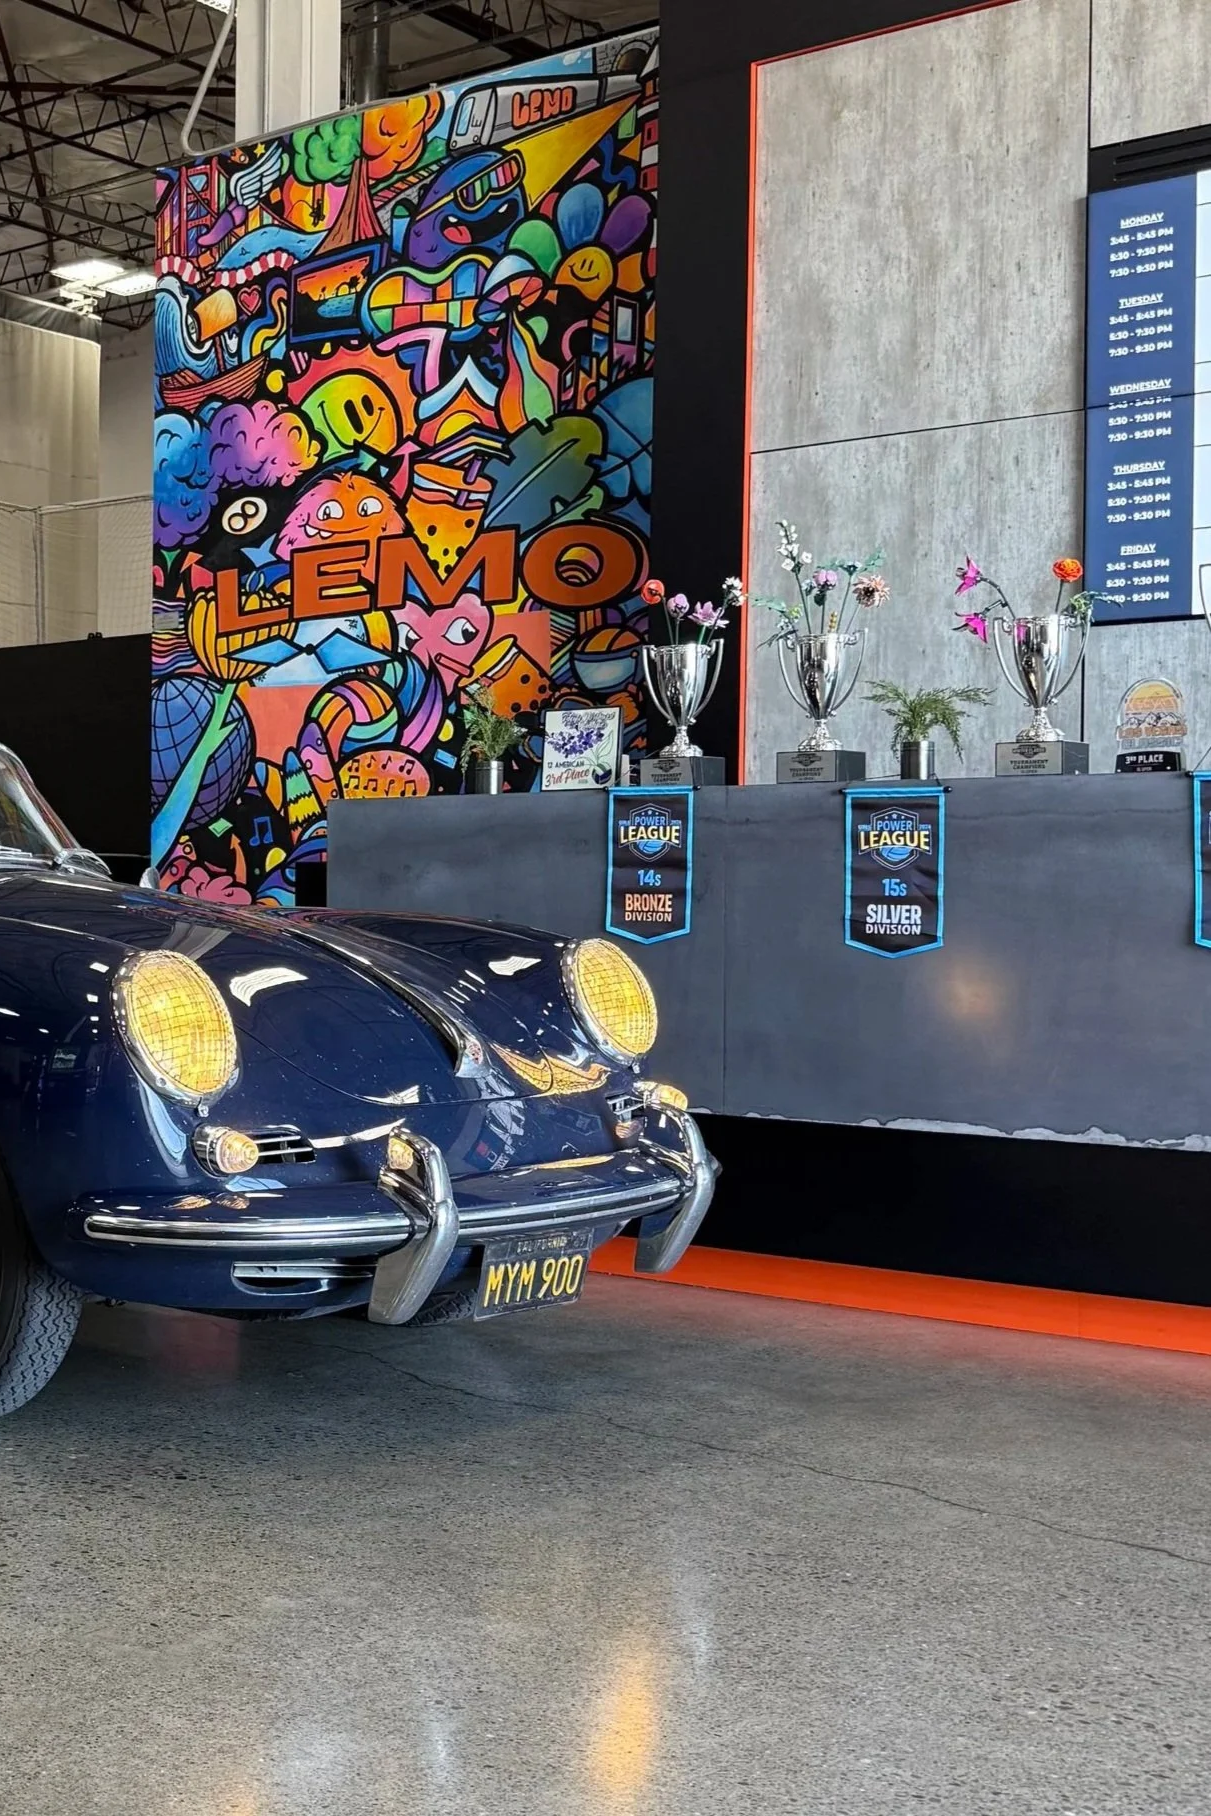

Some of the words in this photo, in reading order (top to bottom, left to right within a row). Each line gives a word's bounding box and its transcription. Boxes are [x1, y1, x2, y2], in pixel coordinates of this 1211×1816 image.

[512, 86, 577, 130] LEMO
[1120, 212, 1164, 229] MONDAY
[1110, 235, 1129, 246] 3:45
[1136, 230, 1156, 241] 5:45
[1157, 227, 1173, 237] PM
[1110, 251, 1129, 262] 5:30
[1136, 247, 1156, 257] 7:30
[1157, 243, 1173, 254] PM
[1110, 267, 1129, 278] 7:30
[1136, 263, 1156, 274] 9:30
[1157, 259, 1173, 270] PM
[1119, 292, 1163, 309] TUESDAY
[1109, 314, 1129, 325] 3:45
[1135, 310, 1155, 321] 5:45
[1157, 307, 1173, 317] PM
[1109, 331, 1129, 341] 5:30
[1135, 327, 1155, 337] 7:30
[1157, 323, 1172, 334] PM
[1109, 347, 1129, 357] 7:30
[1135, 343, 1155, 353] 9:30
[1157, 340, 1172, 350] PM
[1109, 378, 1172, 396] WEDNESDAY
[1108, 416, 1128, 426] 5:30
[1134, 413, 1154, 423] 7:30
[1156, 410, 1171, 420] PM
[1108, 433, 1128, 443] 7:30
[1134, 429, 1154, 439] 9:30
[1156, 427, 1171, 437] PM
[1113, 460, 1165, 475] THURSDAY
[1107, 481, 1127, 491] 3:45
[1133, 478, 1154, 488] 5:45
[1155, 476, 1171, 486] PM
[1107, 497, 1127, 507] 5:30
[1133, 495, 1153, 504] 7:30
[1155, 492, 1171, 502] PM
[1107, 513, 1127, 523] 7:30
[1133, 511, 1153, 521] 9:30
[1155, 508, 1170, 518] PM
[1120, 543, 1156, 556] FRIDAY
[1106, 562, 1126, 571] 3:45
[1132, 560, 1152, 569] 5:45
[1154, 558, 1170, 567] PM
[216, 523, 641, 635] LEMO
[1106, 578, 1126, 588] 5:30
[1132, 576, 1152, 585] 7:30
[1154, 574, 1169, 584] PM
[1154, 590, 1169, 600] PM
[555, 760, 585, 769] AMERICAN
[1138, 753, 1164, 763] PLACE
[545, 769, 564, 787] 3rd
[564, 768, 590, 784] Place
[635, 816, 666, 826] POWER
[877, 820, 913, 831] POWER
[619, 825, 680, 844] LEAGUE
[859, 830, 930, 850] LEAGUE
[637, 869, 662, 887] 14s
[881, 878, 907, 897] 15s
[625, 893, 673, 912] BRONZE
[625, 912, 672, 922] DIVISION
[866, 904, 922, 925] SILVER
[865, 924, 921, 935] DIVISION
[484, 1259, 537, 1308] MYM
[538, 1254, 584, 1299] 900
